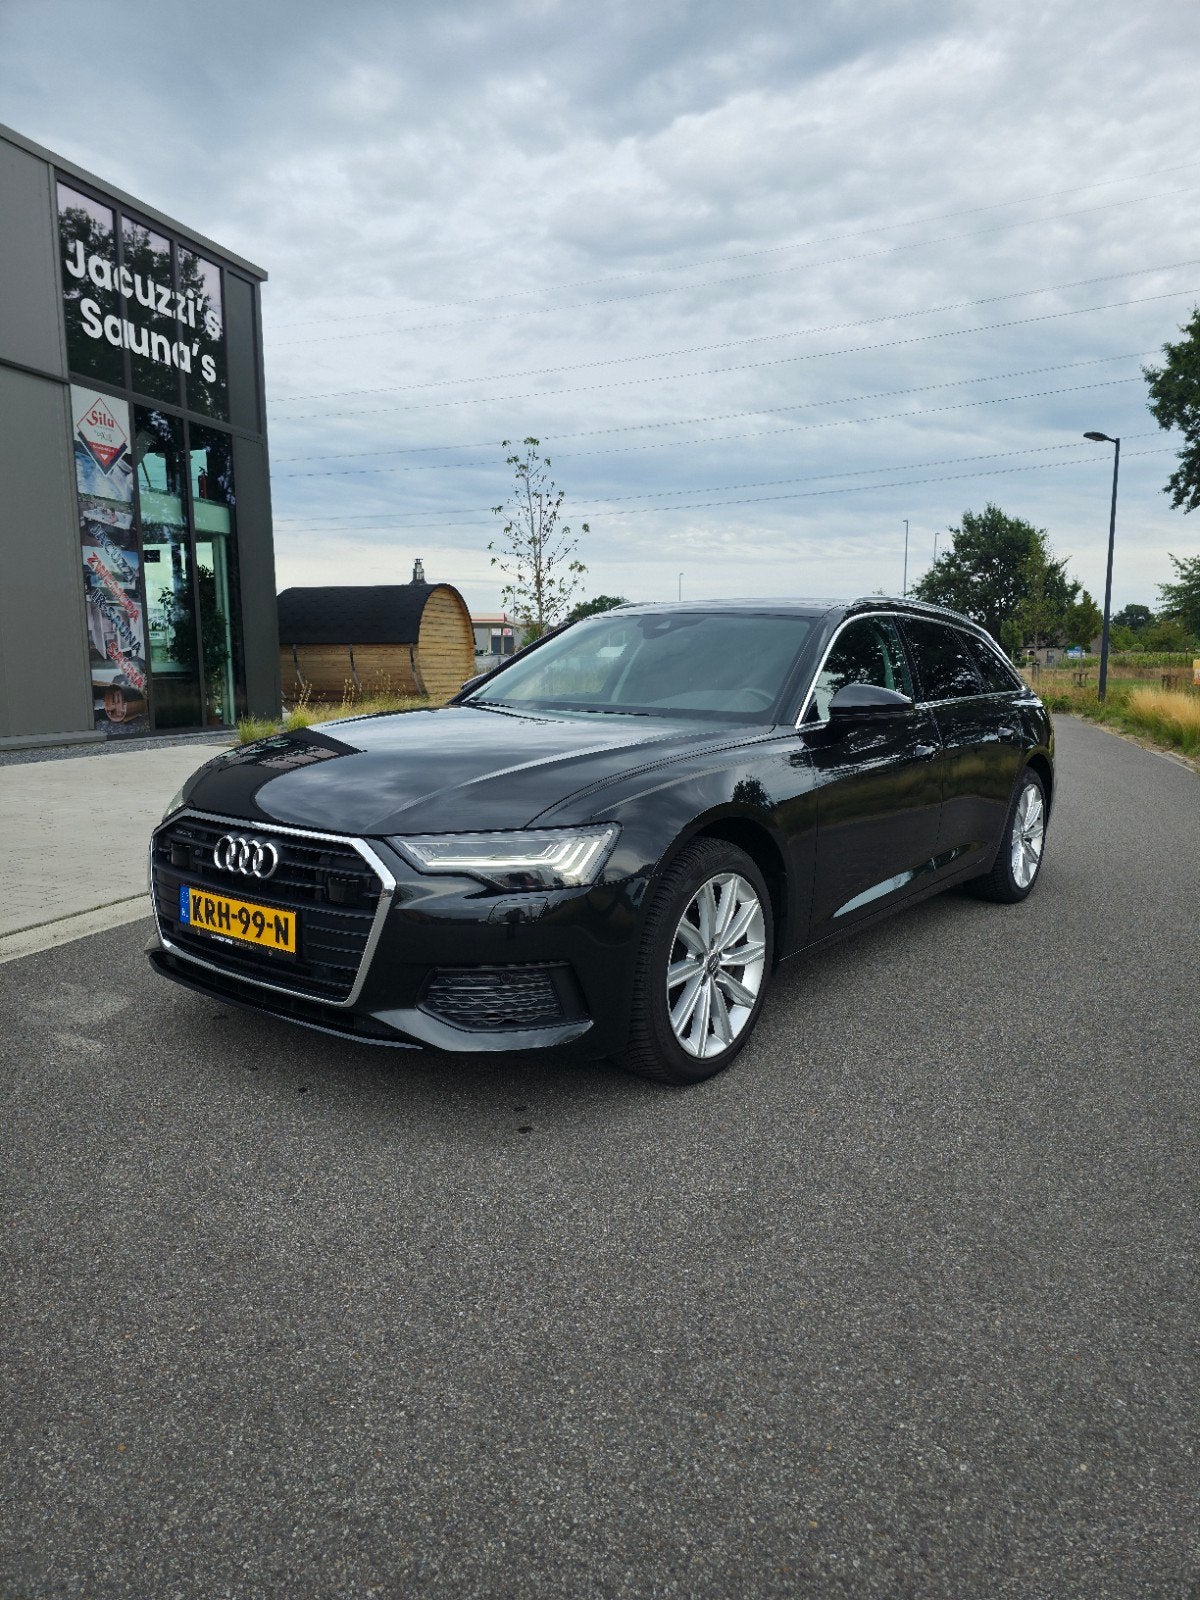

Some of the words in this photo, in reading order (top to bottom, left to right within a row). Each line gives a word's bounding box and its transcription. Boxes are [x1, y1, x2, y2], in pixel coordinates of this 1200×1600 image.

[66, 240, 222, 341] Jacuzzi's
[80, 298, 217, 383] Sauna's
[86, 410, 115, 428] Silu
[191, 894, 289, 945] KRH-99-N
